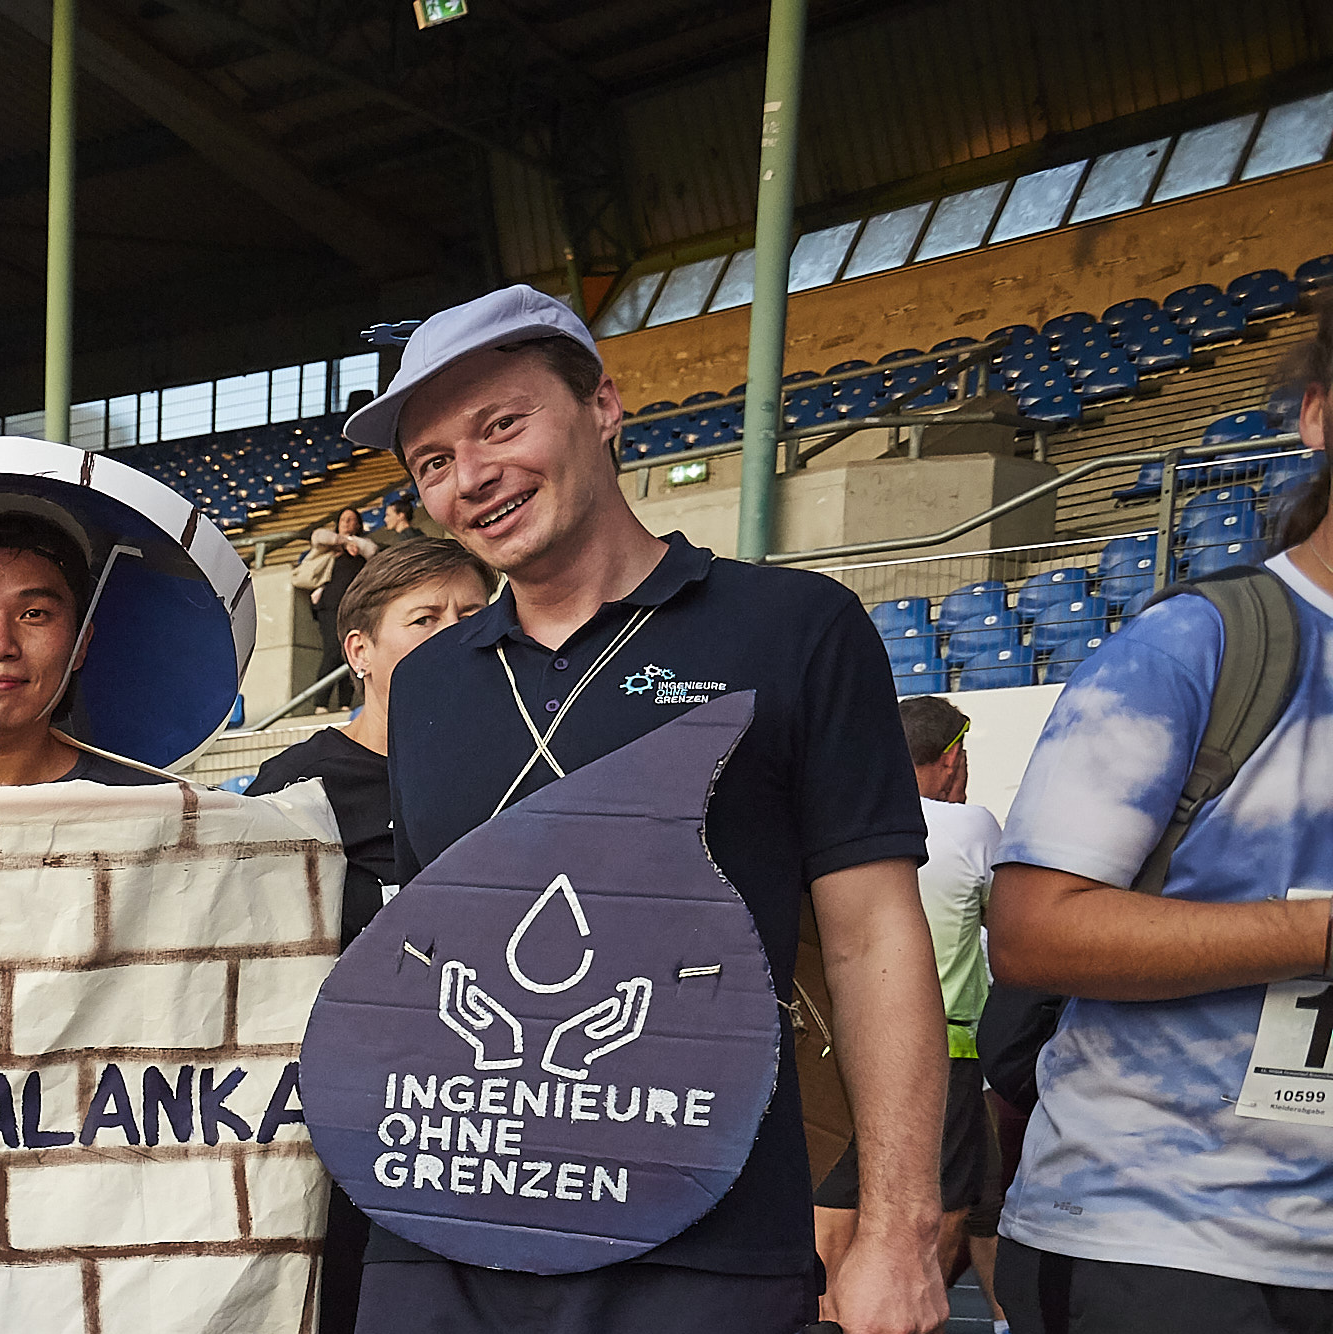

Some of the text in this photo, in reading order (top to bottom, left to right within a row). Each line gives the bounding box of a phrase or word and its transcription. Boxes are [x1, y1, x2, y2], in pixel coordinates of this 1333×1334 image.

[656, 688, 689, 697] OHNE
[658, 681, 727, 691] INGENIEURE
[654, 694, 709, 704] GRENZEN
[384, 1072, 716, 1127] INGENIEURE
[1274, 1089, 1326, 1103] 10599
[377, 1112, 525, 1156] OHNE
[373, 1151, 629, 1203] GRENZEN
